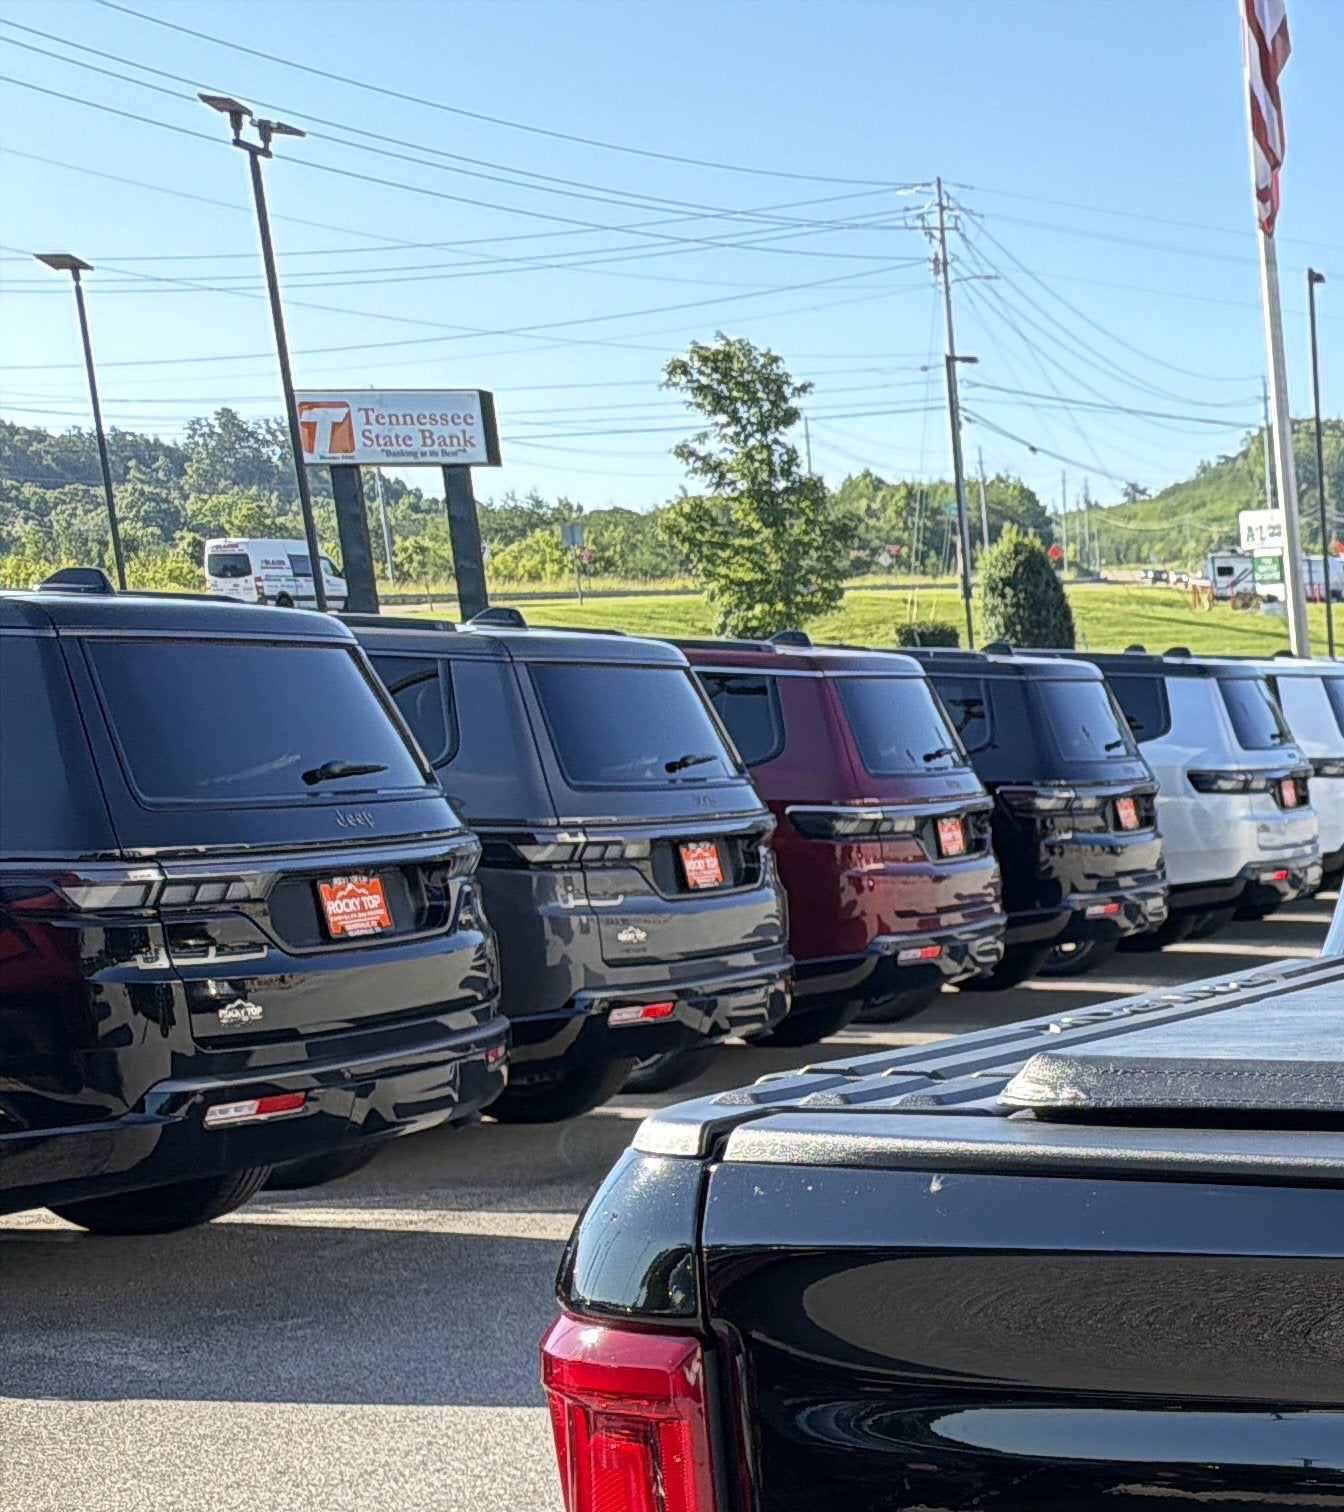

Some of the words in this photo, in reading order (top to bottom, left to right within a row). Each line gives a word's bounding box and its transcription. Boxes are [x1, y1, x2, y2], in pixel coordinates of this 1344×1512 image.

[358, 407, 474, 426] Tennessee
[361, 428, 413, 448] State
[419, 428, 476, 448] Bank
[327, 897, 360, 915] ROCKY
[360, 895, 381, 910] TOP
